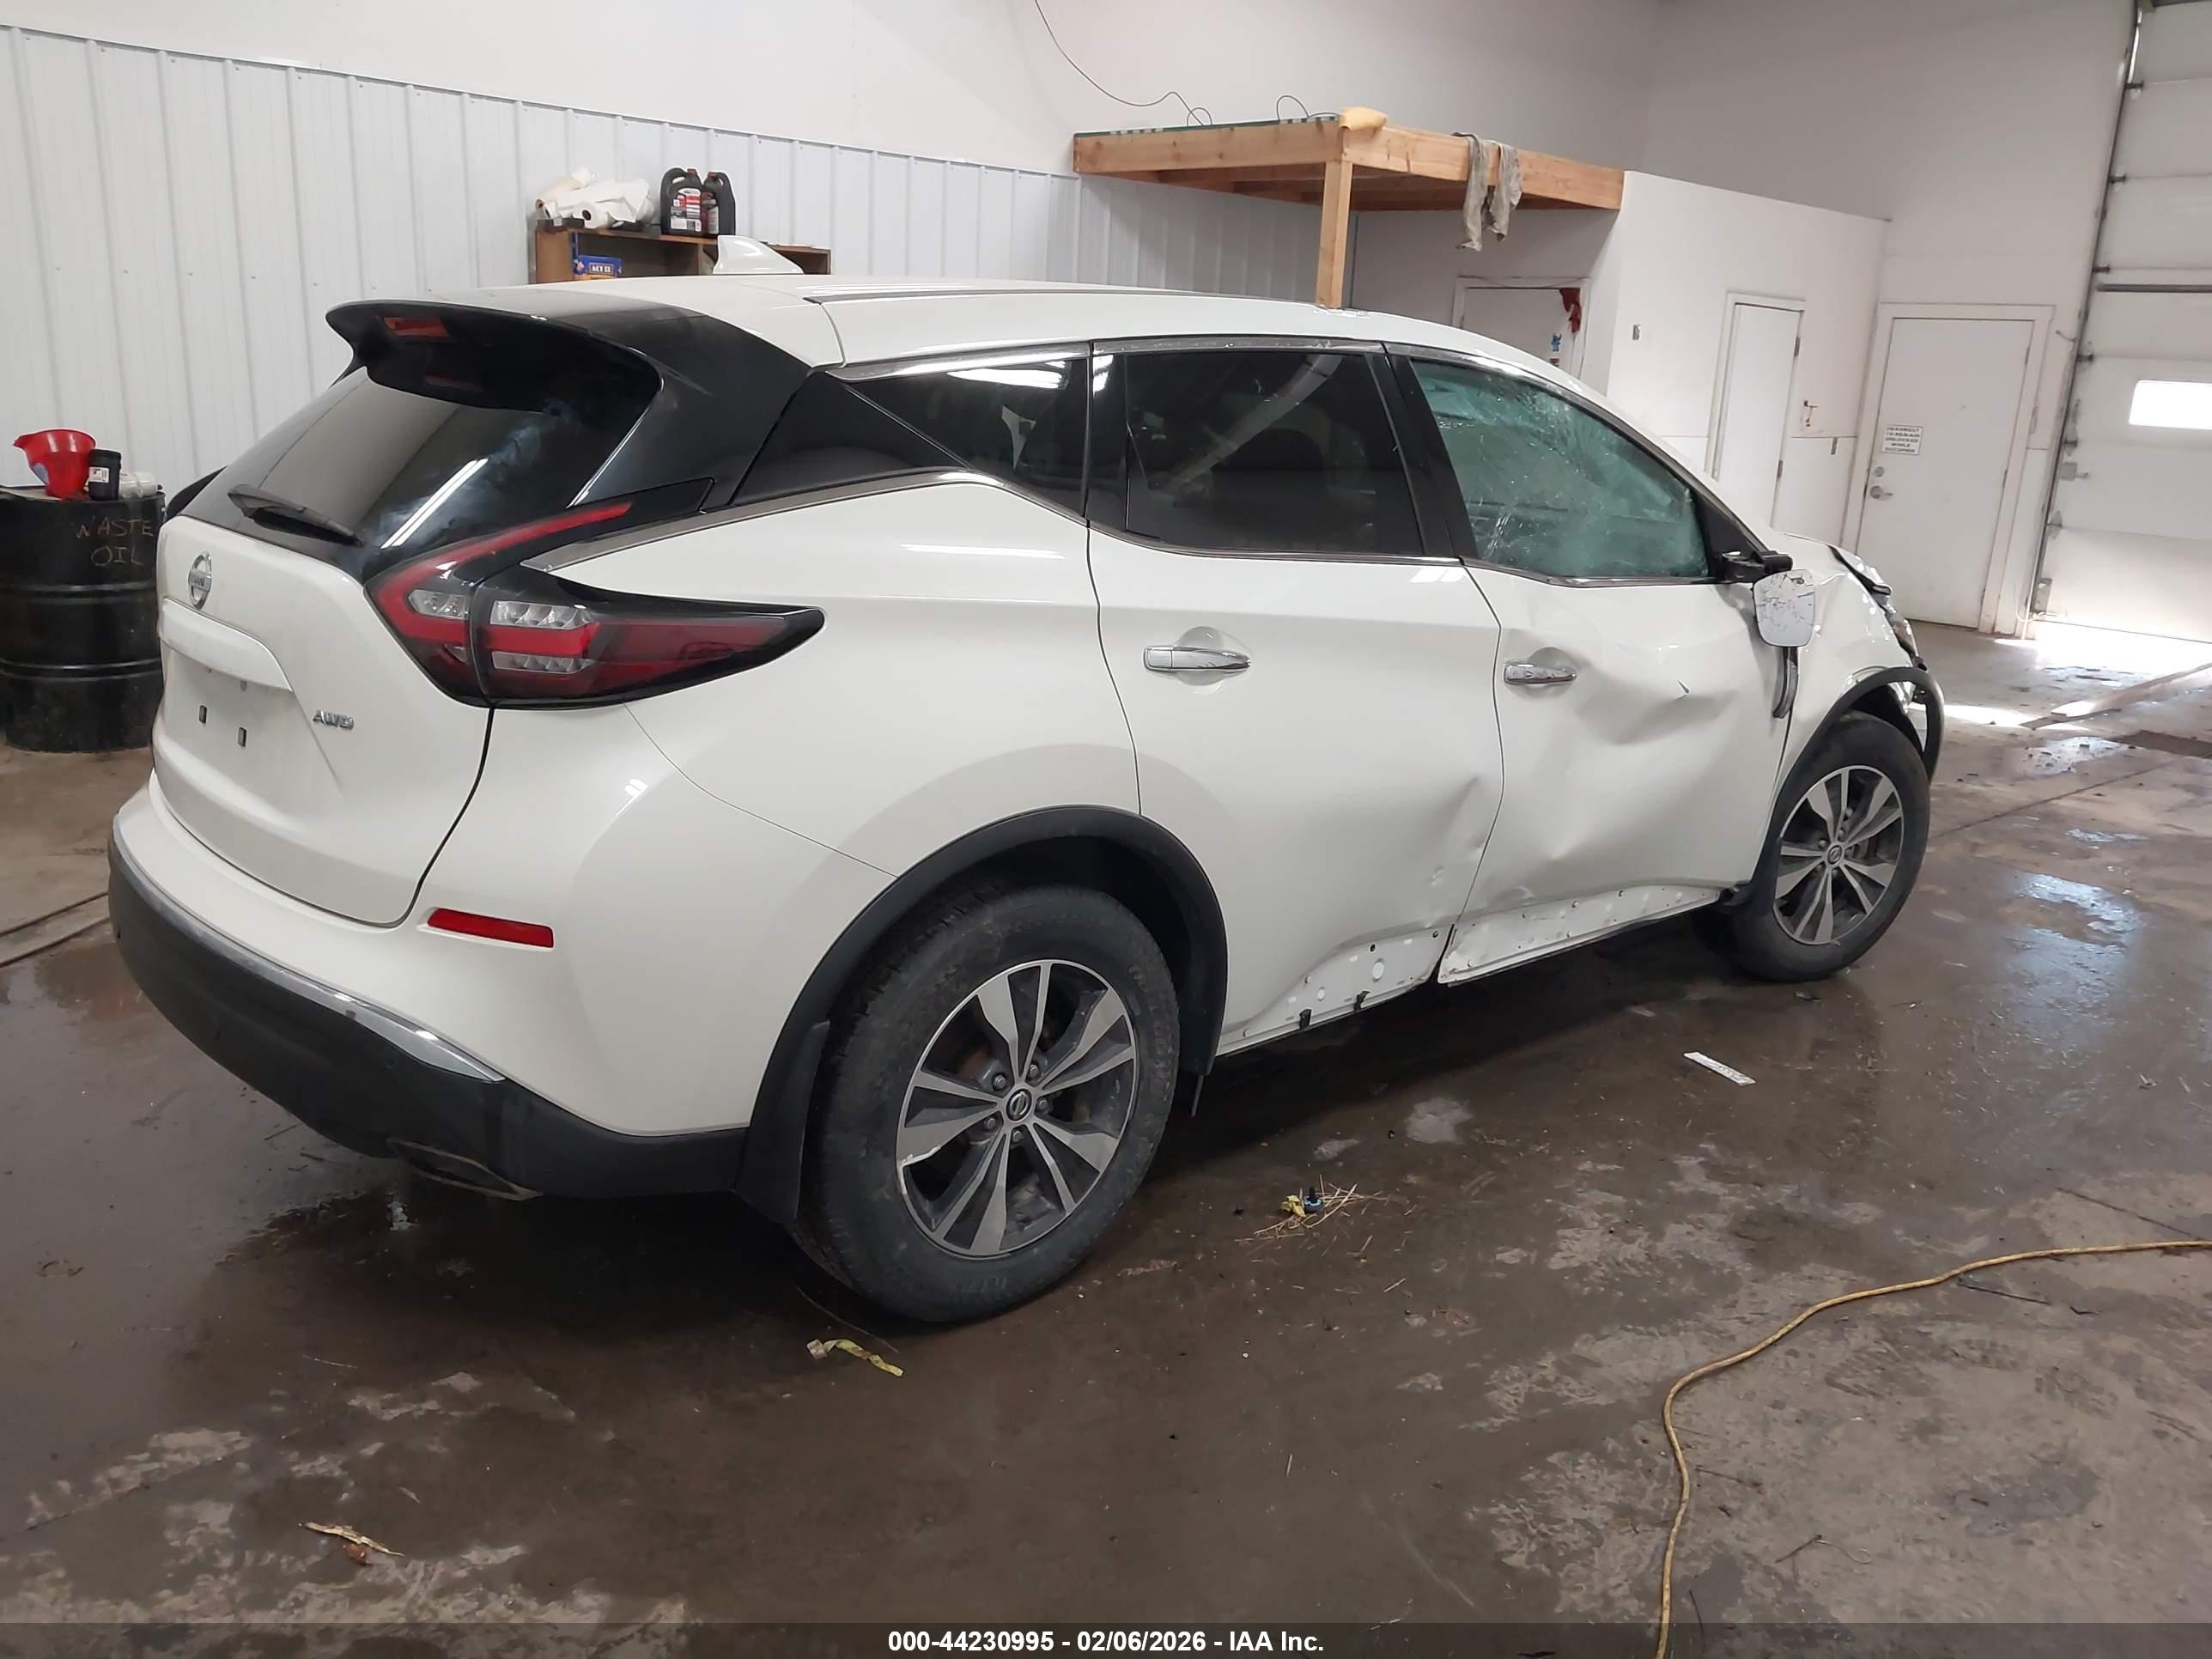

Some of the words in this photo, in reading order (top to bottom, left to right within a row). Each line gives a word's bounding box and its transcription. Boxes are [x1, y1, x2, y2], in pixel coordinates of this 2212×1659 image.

[74, 517, 154, 538] WASTE
[90, 545, 144, 567] OIL
[313, 709, 355, 730] AWD
